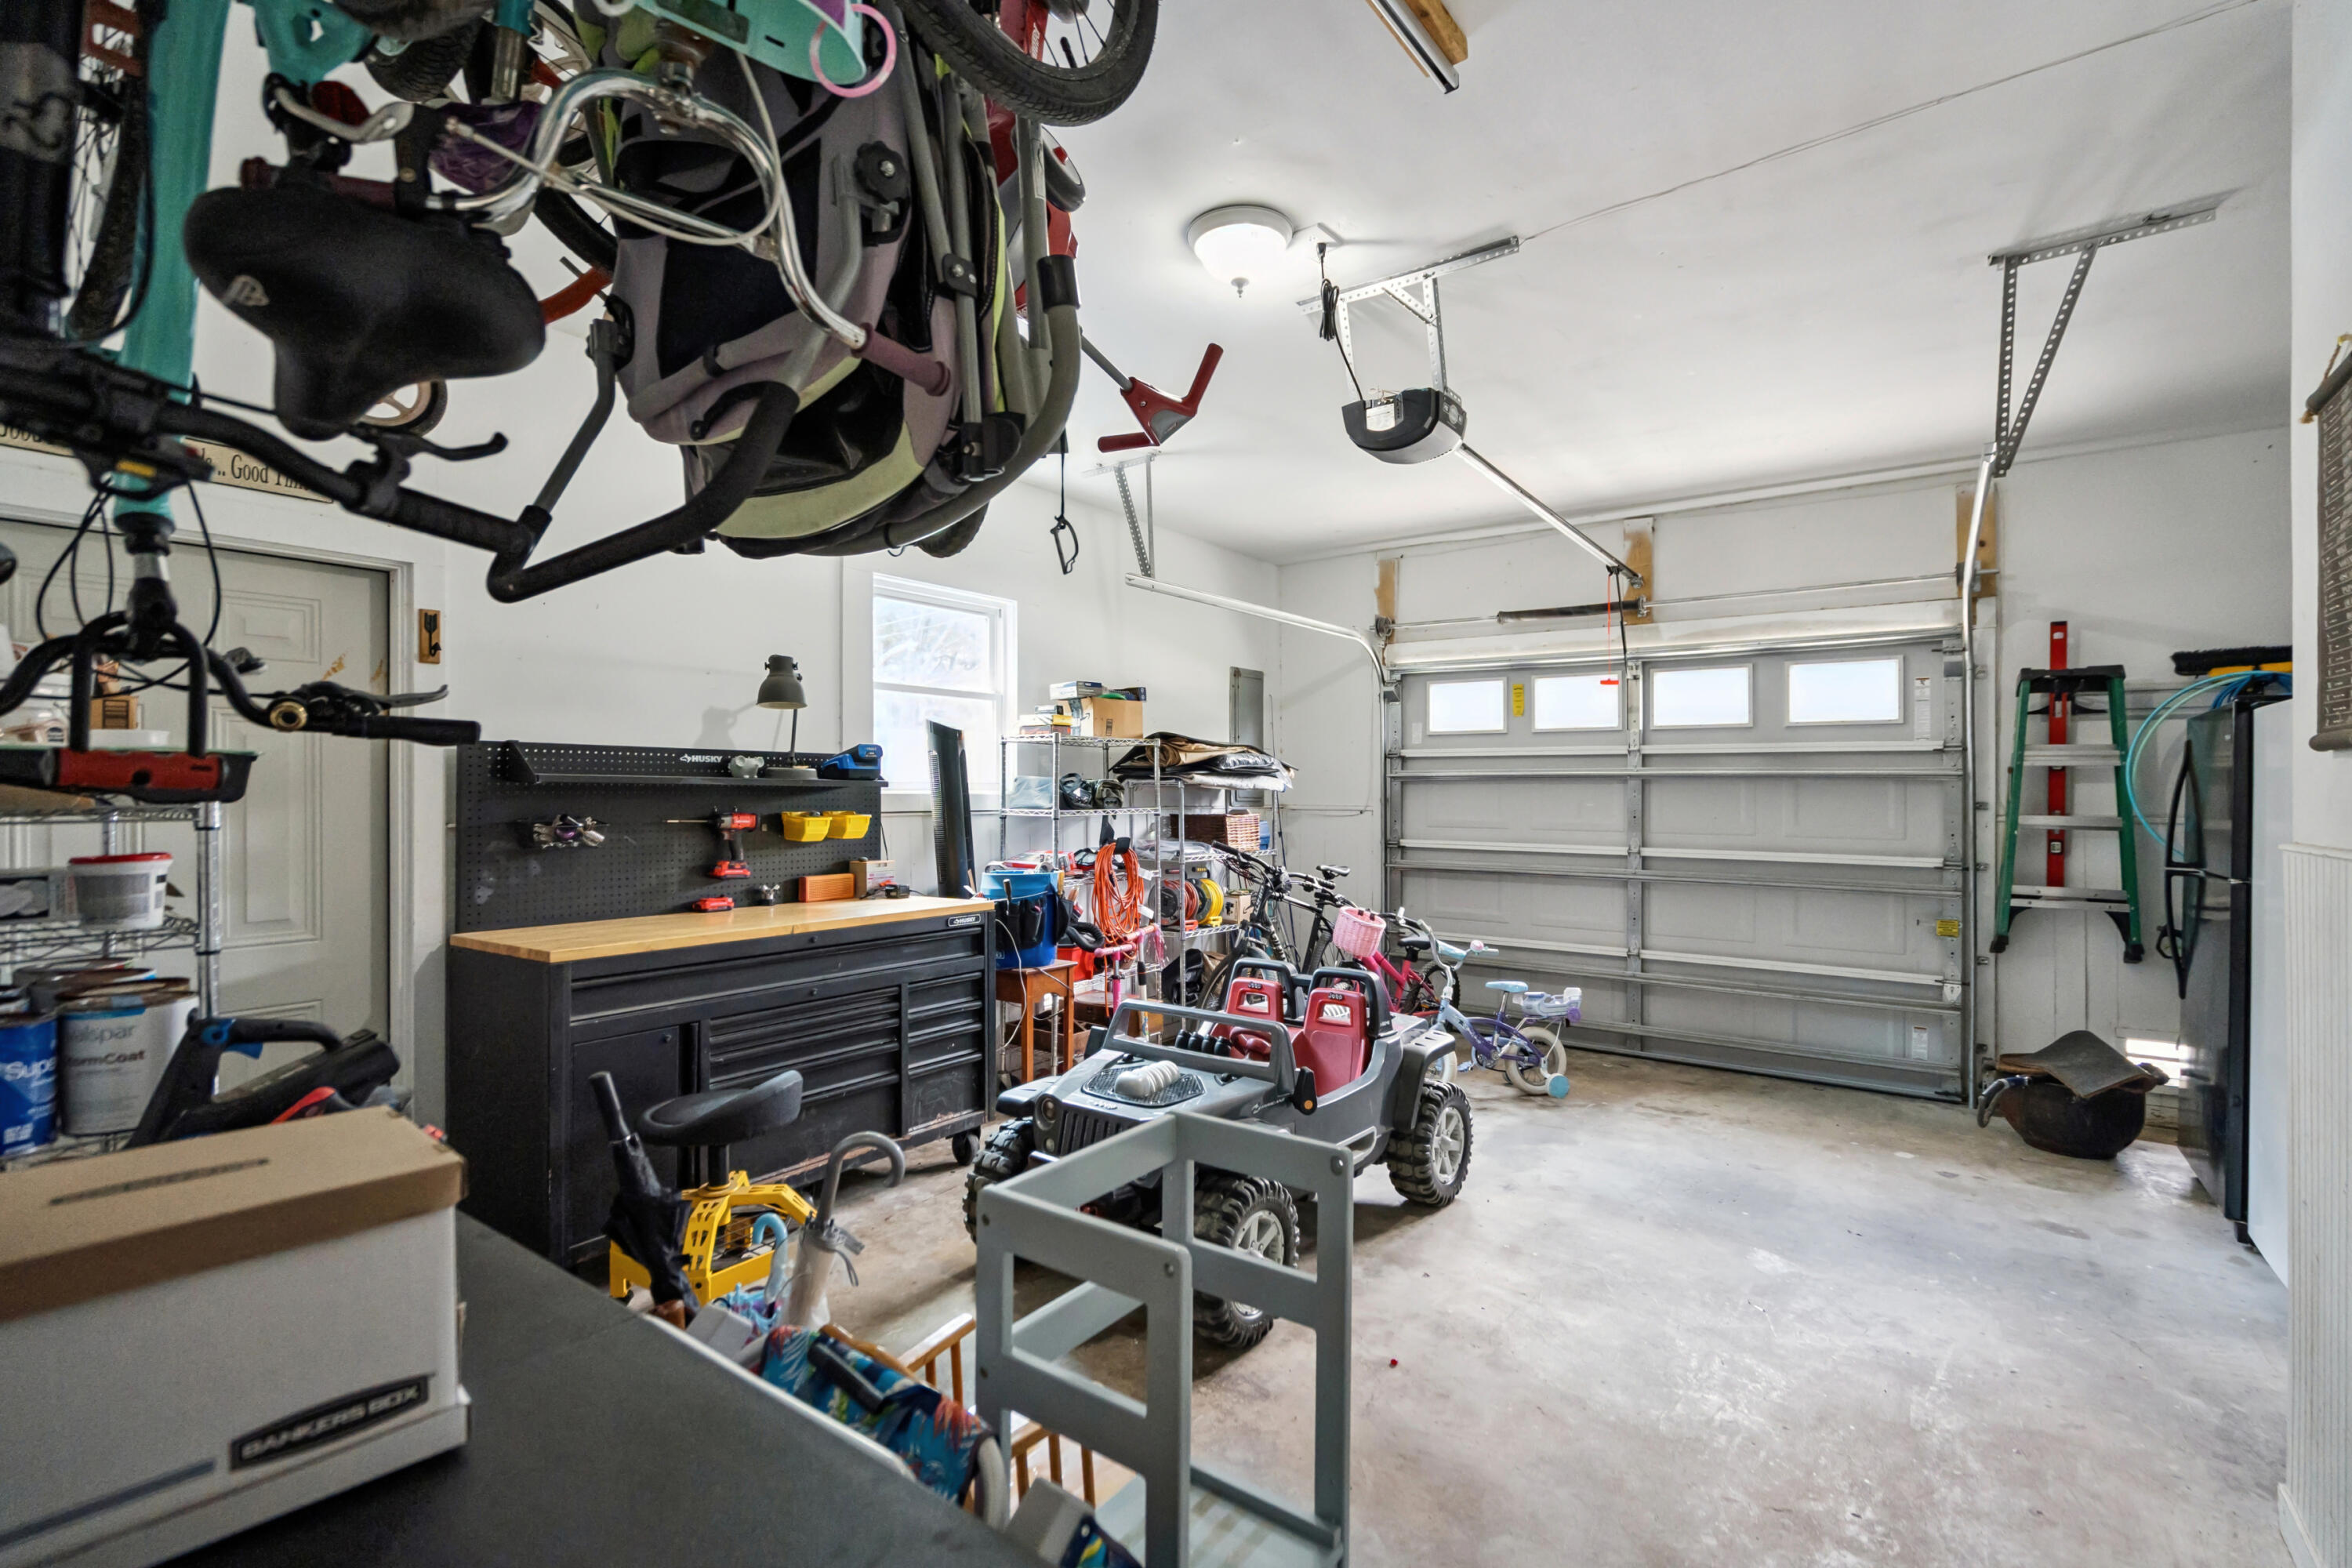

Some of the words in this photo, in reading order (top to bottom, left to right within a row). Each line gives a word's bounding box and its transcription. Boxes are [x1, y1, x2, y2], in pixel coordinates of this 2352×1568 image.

[231, 454, 269, 483] Good
[691, 754, 723, 763] HUSKY
[1328, 992, 1343, 1000] Jeep
[241, 1403, 366, 1461] BANKERS
[368, 1385, 419, 1413] BOX
